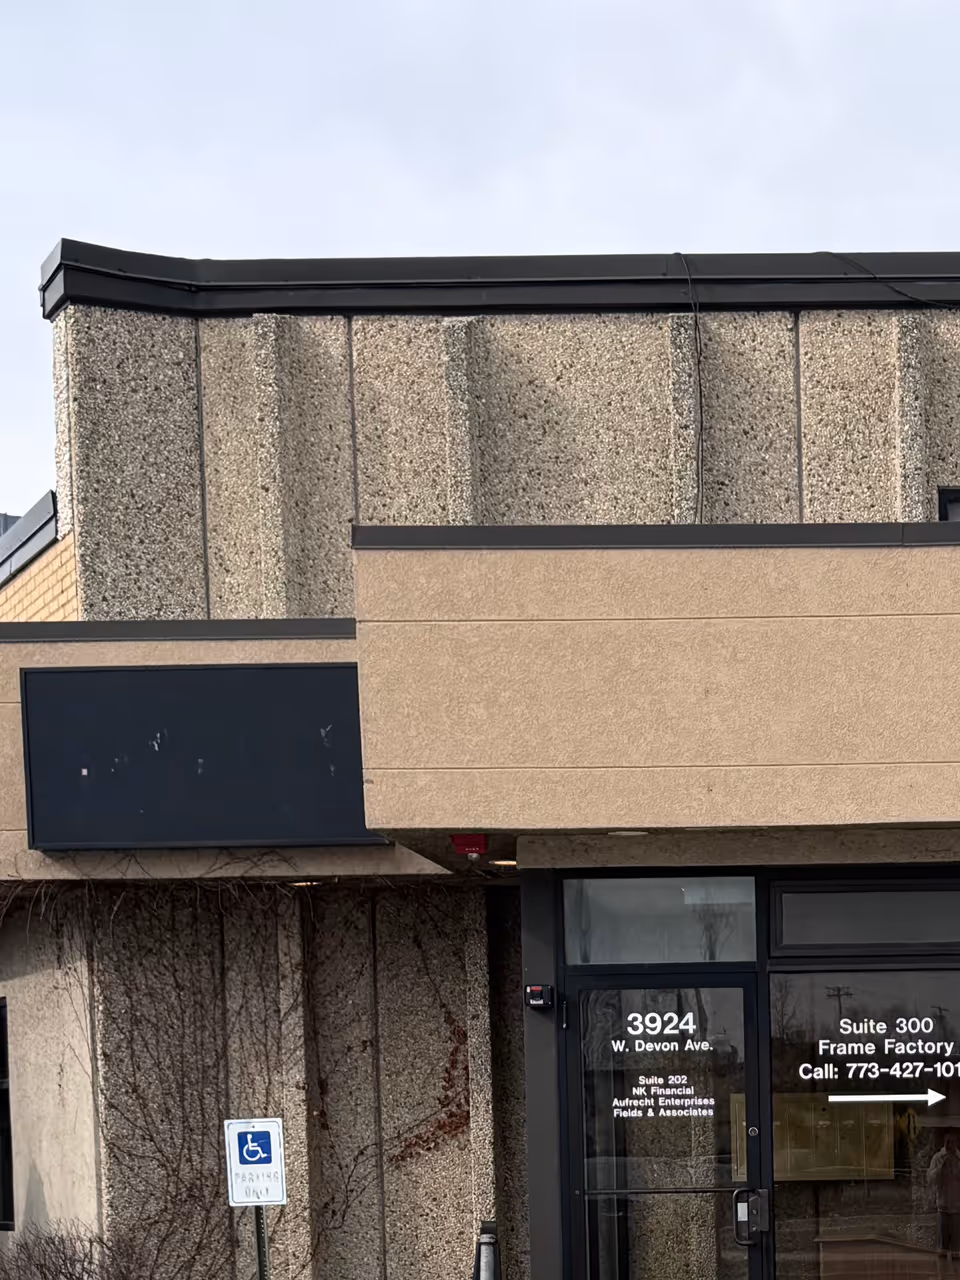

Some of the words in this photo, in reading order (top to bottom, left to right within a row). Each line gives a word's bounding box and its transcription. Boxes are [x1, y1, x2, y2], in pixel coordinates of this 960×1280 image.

[626, 1012, 697, 1035] 3924
[839, 1018, 887, 1035] Suite
[895, 1017, 934, 1034] 300
[611, 1039, 630, 1052] W.
[635, 1039, 679, 1052] Devon
[684, 1038, 714, 1051] Ave.
[818, 1039, 876, 1055] Frame
[884, 1038, 954, 1057] Factory
[799, 1063, 839, 1079] Call:
[638, 1075, 664, 1085] Suite
[667, 1075, 688, 1085] 202
[632, 1087, 647, 1096] NK
[650, 1086, 695, 1095] Financial
[612, 1097, 654, 1107] Aufrecht
[658, 1096, 715, 1107] Enterprises
[613, 1108, 643, 1117] Fields
[647, 1108, 654, 1117] &
[658, 1107, 714, 1117] Associates
